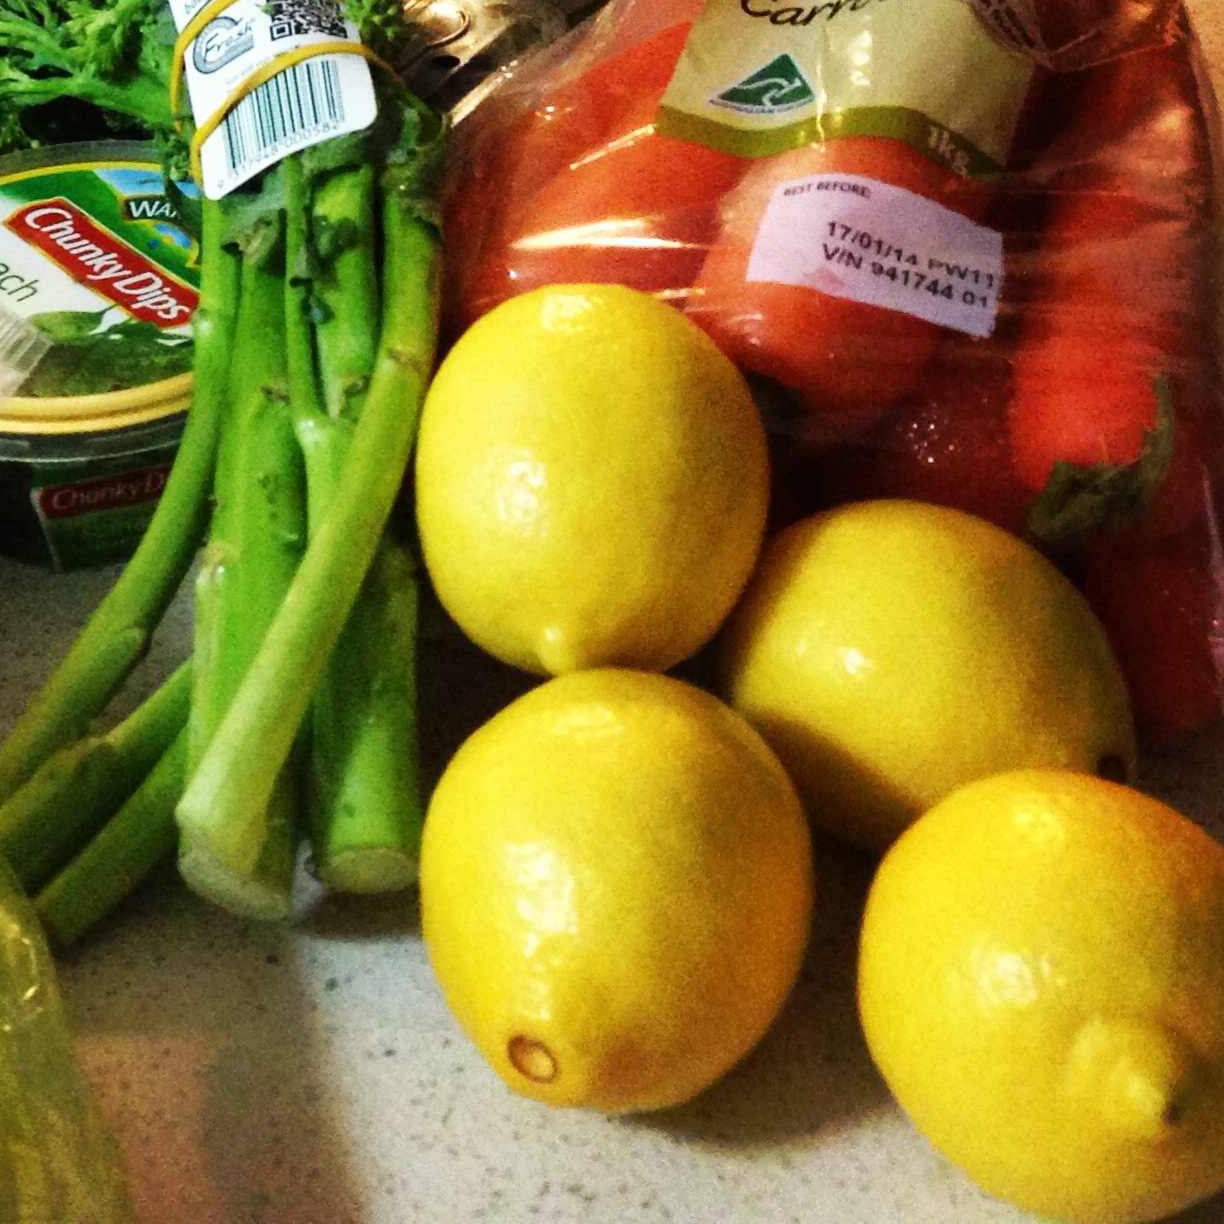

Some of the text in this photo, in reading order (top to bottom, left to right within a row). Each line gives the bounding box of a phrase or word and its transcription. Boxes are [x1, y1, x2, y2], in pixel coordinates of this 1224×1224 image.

[783, 182, 813, 197] BEST
[129, 199, 177, 218] WA
[827, 221, 919, 267] 17/01/14
[24, 207, 191, 320] Chunky Dips
[52, 480, 137, 510] Chunky
